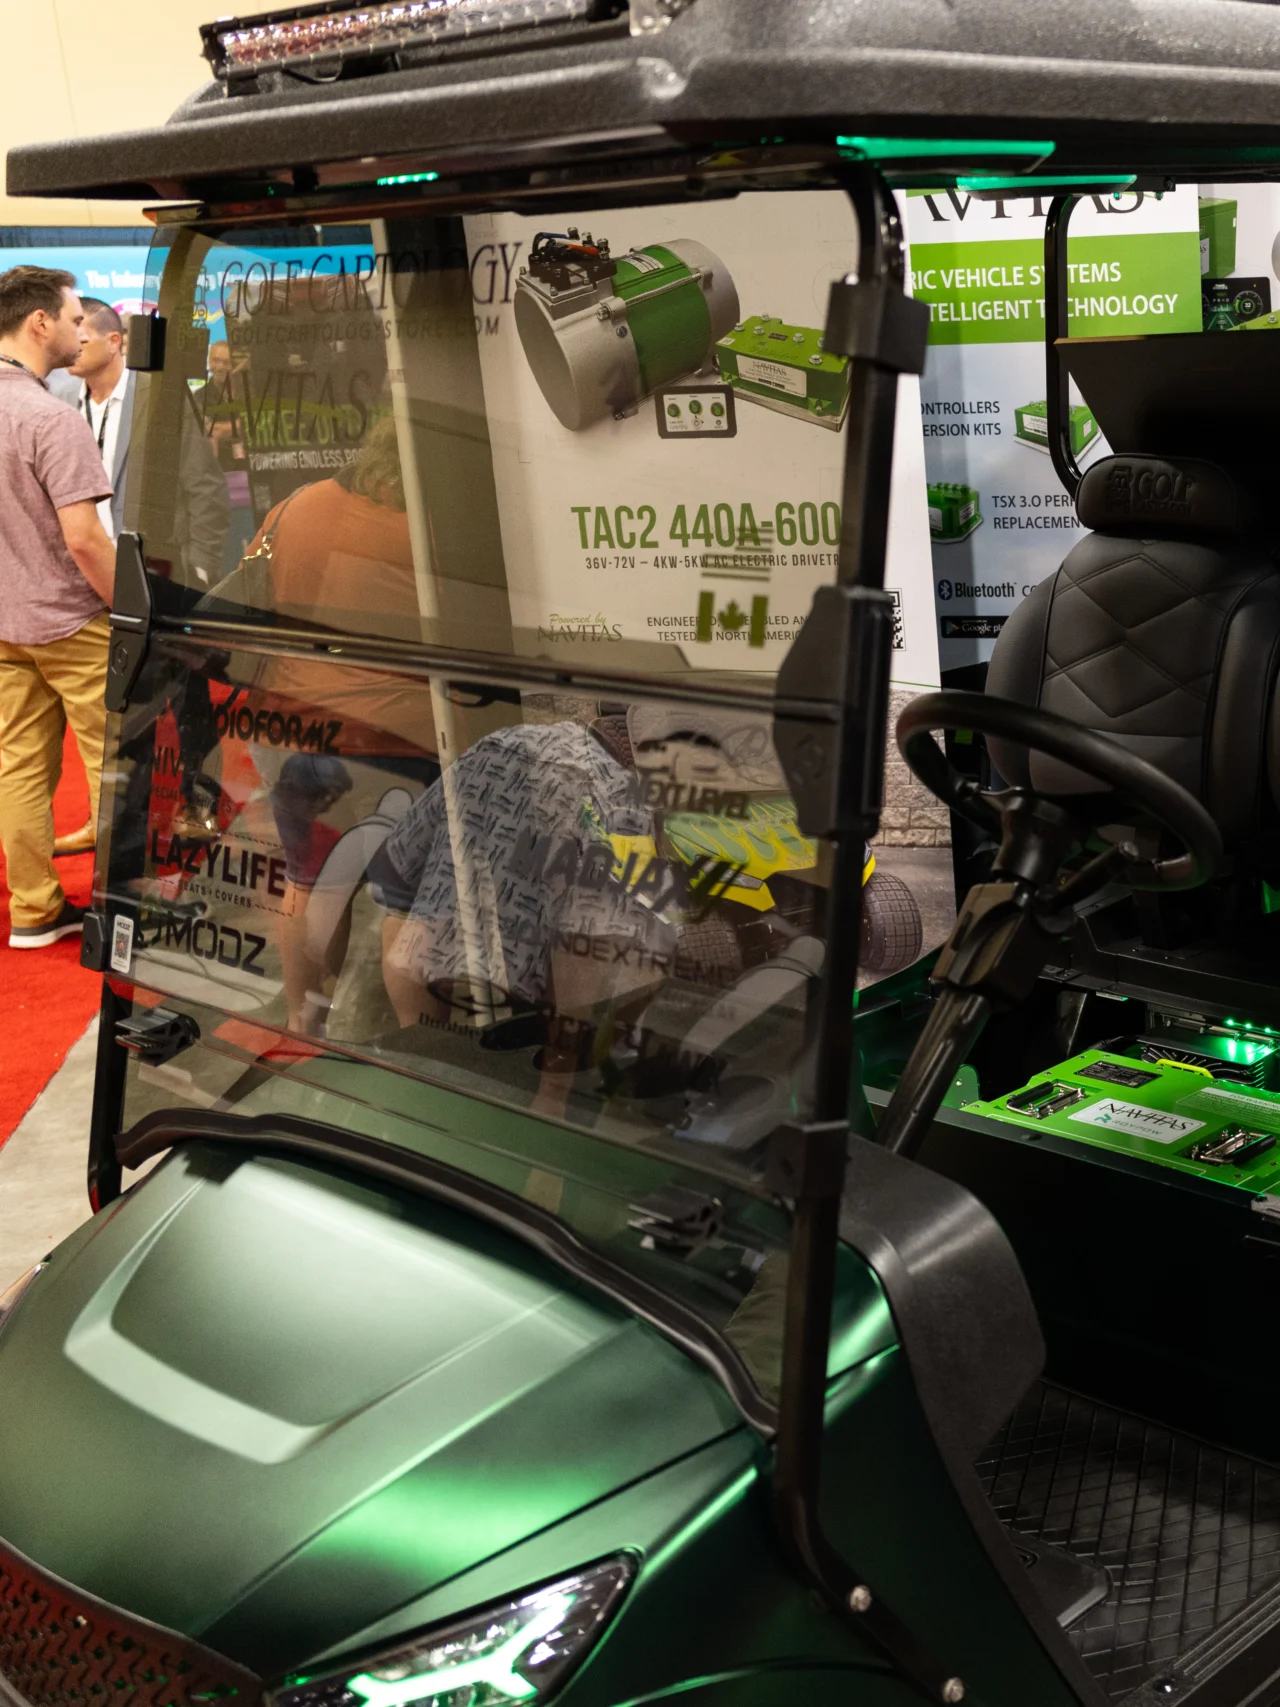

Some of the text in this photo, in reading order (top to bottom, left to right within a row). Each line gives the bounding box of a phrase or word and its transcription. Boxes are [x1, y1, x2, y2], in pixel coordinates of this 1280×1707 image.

[220, 260, 303, 319] GOLF
[940, 266, 1024, 289] VEHICLE
[1030, 262, 1122, 286] STEMS
[929, 293, 1179, 322] TELLIGENT TCHNOLOGY
[176, 366, 368, 441] NAVITAS
[974, 422, 1001, 436] KITS
[992, 495, 1016, 508] TSX
[571, 505, 659, 550] TAC2
[585, 557, 636, 570] 36V-72V
[653, 556, 709, 569] 4KW-5KW
[714, 555, 728, 568] AC
[732, 554, 788, 568] ELECTRIC
[549, 611, 607, 626] Powered by
[537, 623, 623, 643] NAVITAS
[151, 828, 288, 899] LAZYLIFE
[215, 889, 253, 909] COVERS
[166, 910, 266, 976] MODZ
[1100, 1102, 1195, 1132] NAVITAS
